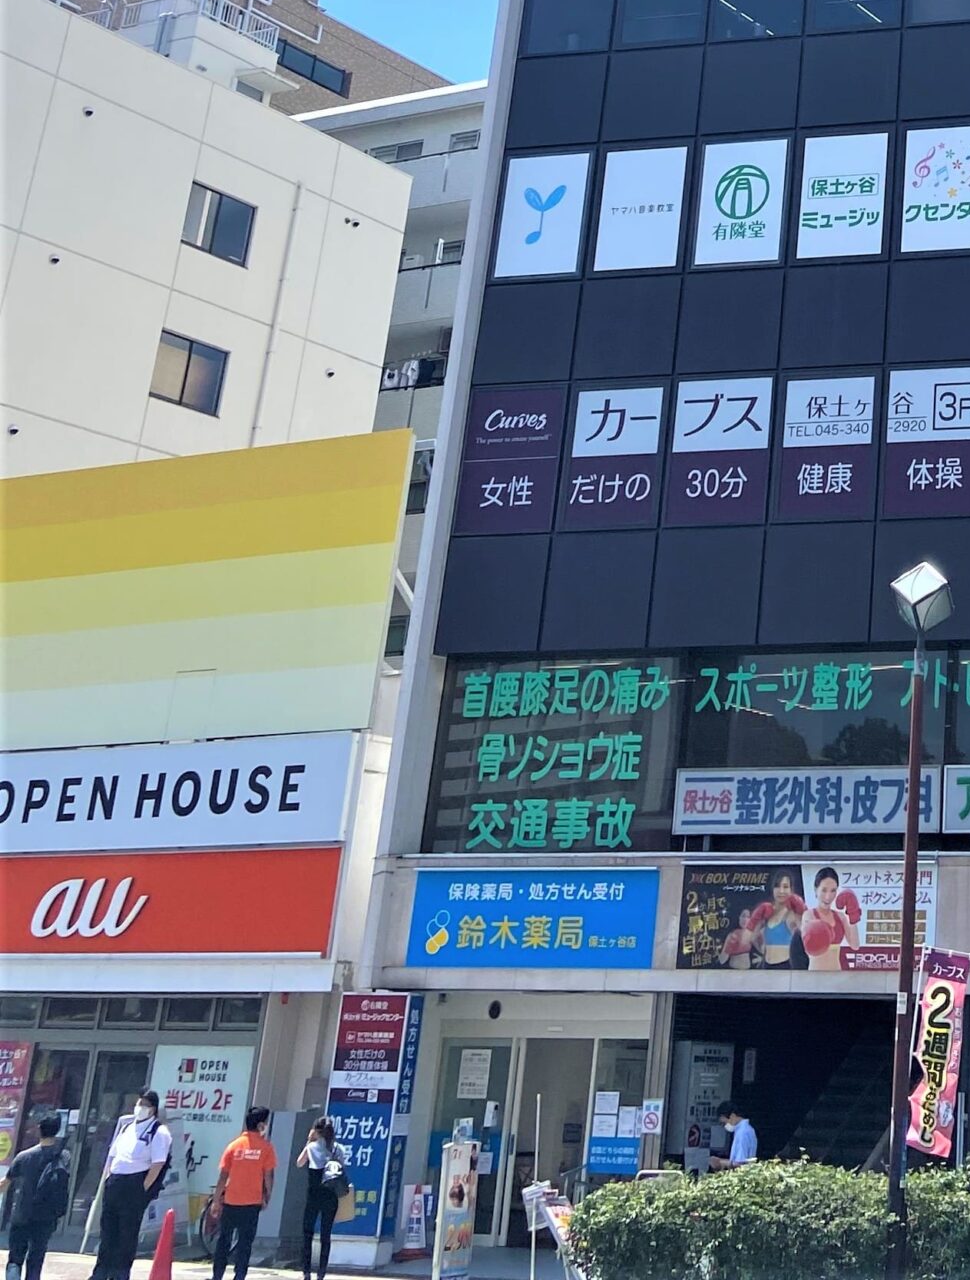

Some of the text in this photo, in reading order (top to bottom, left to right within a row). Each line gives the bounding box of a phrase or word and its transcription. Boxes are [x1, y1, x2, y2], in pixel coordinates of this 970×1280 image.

[810, 176, 876, 197] 保土ヶ谷
[610, 202, 675, 217] ヤマハ音楽教室
[711, 220, 767, 241] 有隣堂
[584, 392, 763, 443] カーブス
[806, 391, 914, 420] 保土ヶ谷
[483, 408, 548, 432] Curves
[479, 457, 964, 507] 女性 だけの 30分 健康 体操
[462, 666, 670, 718] 首腰膝足の痛み
[695, 662, 873, 711] スポーツ整形
[477, 730, 643, 782] 骨ソショウ症
[133, 764, 306, 819] HOUSE
[683, 788, 733, 815] 保土ヶ谷
[465, 796, 637, 849] 交通事故
[705, 872, 769, 884] BOX PRIME
[841, 870, 933, 886] フィットネス門
[448, 882, 626, 902] 保険薬局・処方せん受付
[30, 876, 149, 939] au
[456, 914, 584, 950] 鈴木薬局
[587, 934, 637, 949] 保土ヶ谷店
[853, 952, 898, 961] BOXPLU
[932, 961, 966, 979] カーブス
[200, 1060, 229, 1070] OPEN
[349, 1049, 386, 1059] 女性だけの
[398, 1009, 420, 1114] 処方せん受付
[198, 1073, 227, 1082] HOUSE
[164, 1088, 233, 1111] 当ビル 2F
[331, 1115, 389, 1140] 処方せん
